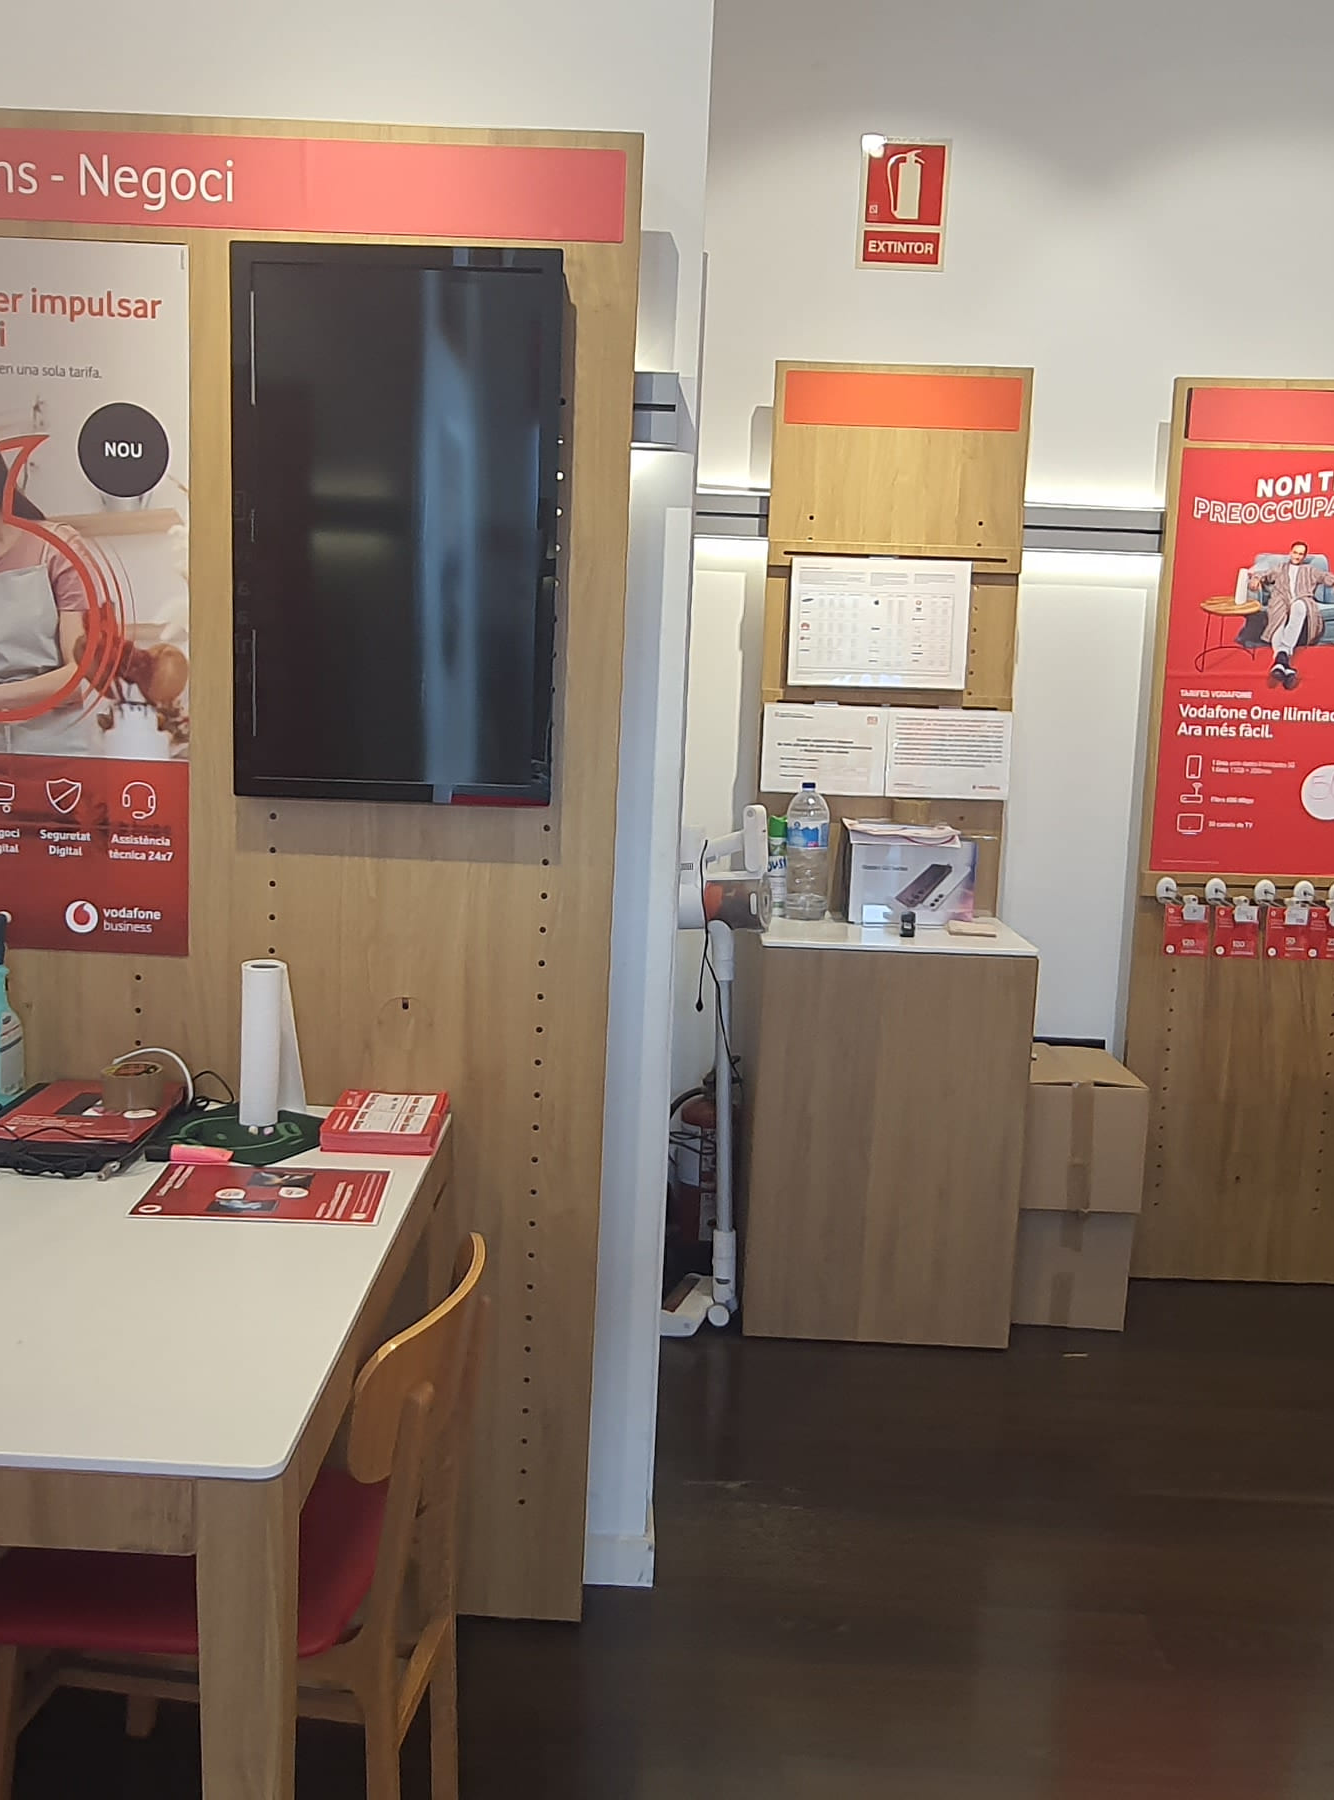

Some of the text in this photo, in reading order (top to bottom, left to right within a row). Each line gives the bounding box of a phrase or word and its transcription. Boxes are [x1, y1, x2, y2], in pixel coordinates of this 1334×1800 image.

[78, 155, 235, 211] Negoci
[868, 240, 934, 255] EXTINTOR
[31, 287, 163, 322] impulsar
[17, 365, 39, 376] una
[42, 364, 66, 377] sola
[68, 365, 103, 379] tarifa.
[104, 441, 144, 459] NOU
[1256, 473, 1311, 498] NON
[1178, 703, 1249, 721] Vodafone
[1250, 706, 1281, 721] One
[1177, 722, 1274, 739] Ara més fàcil.
[39, 829, 92, 844] Seguretat
[48, 844, 83, 858] Digital
[148, 850, 174, 863] 24x7
[103, 907, 162, 922] vodafone
[103, 919, 153, 934] business
